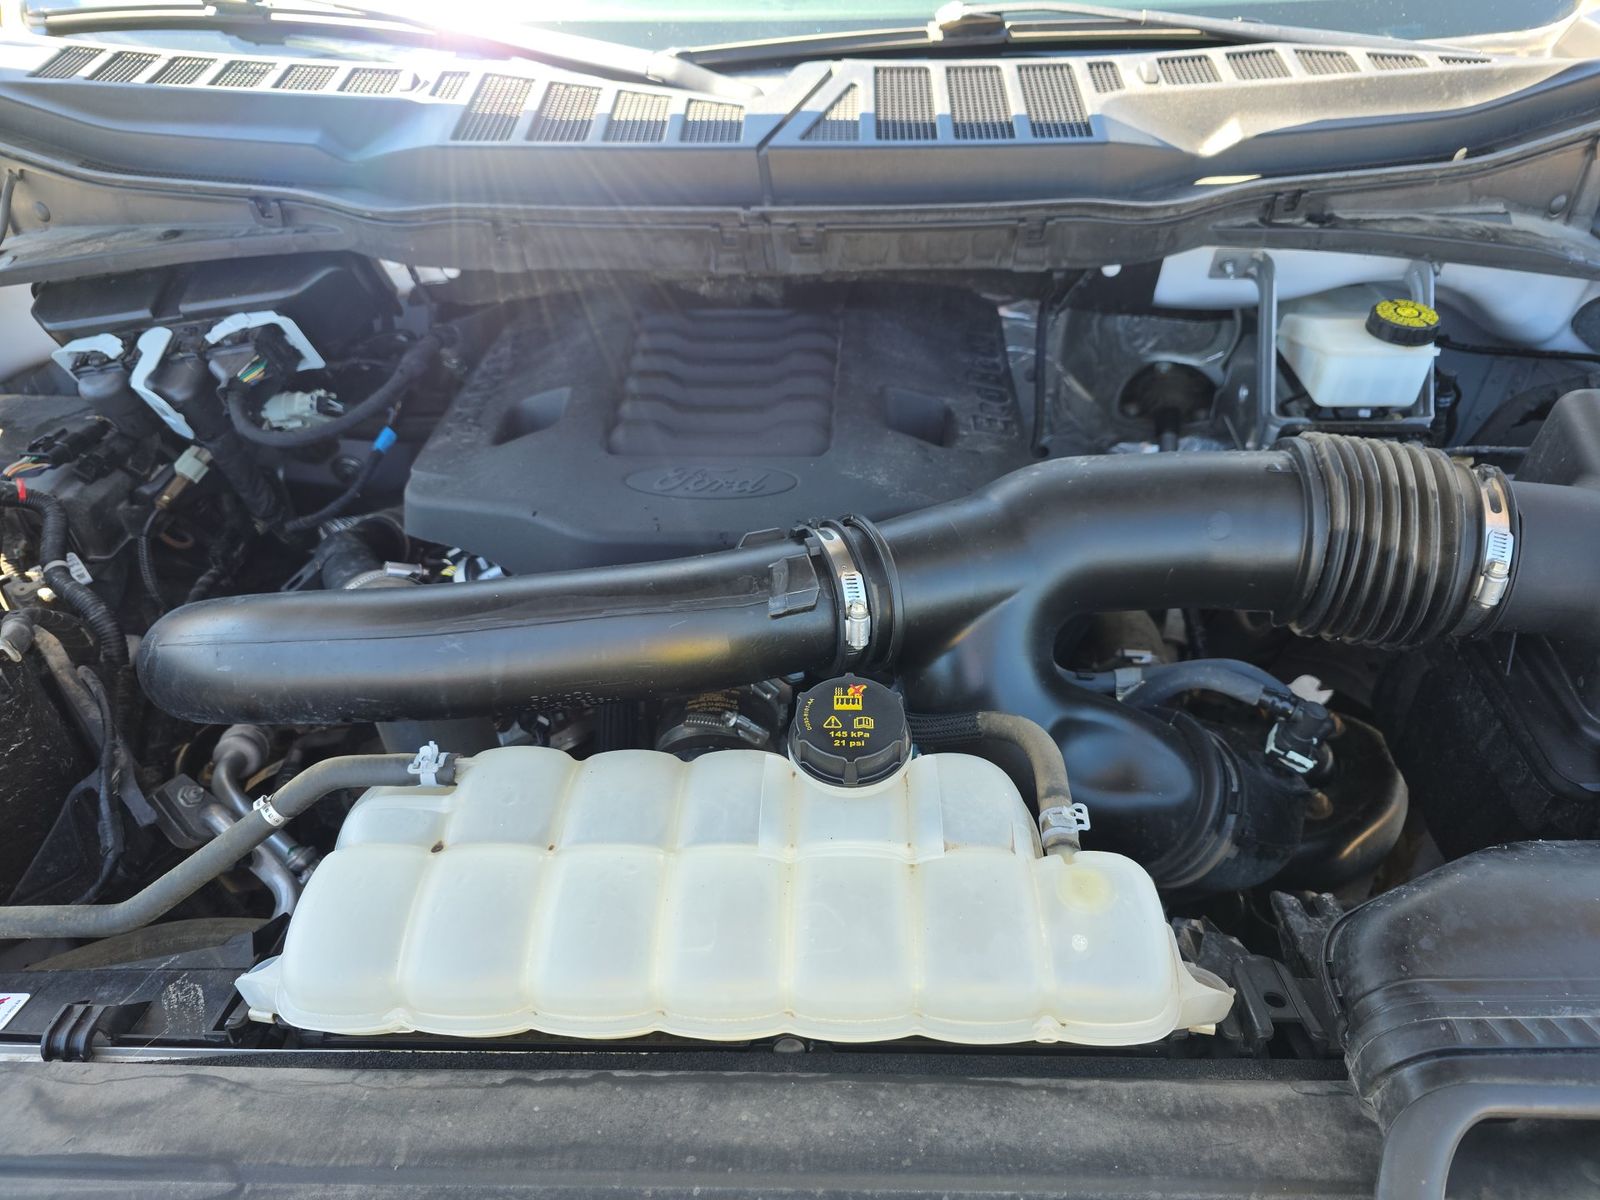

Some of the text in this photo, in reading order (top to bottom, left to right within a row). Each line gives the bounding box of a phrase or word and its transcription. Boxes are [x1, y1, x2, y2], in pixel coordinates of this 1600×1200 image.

[653, 467, 771, 494] Ford
[833, 739, 865, 748] 21 psi
